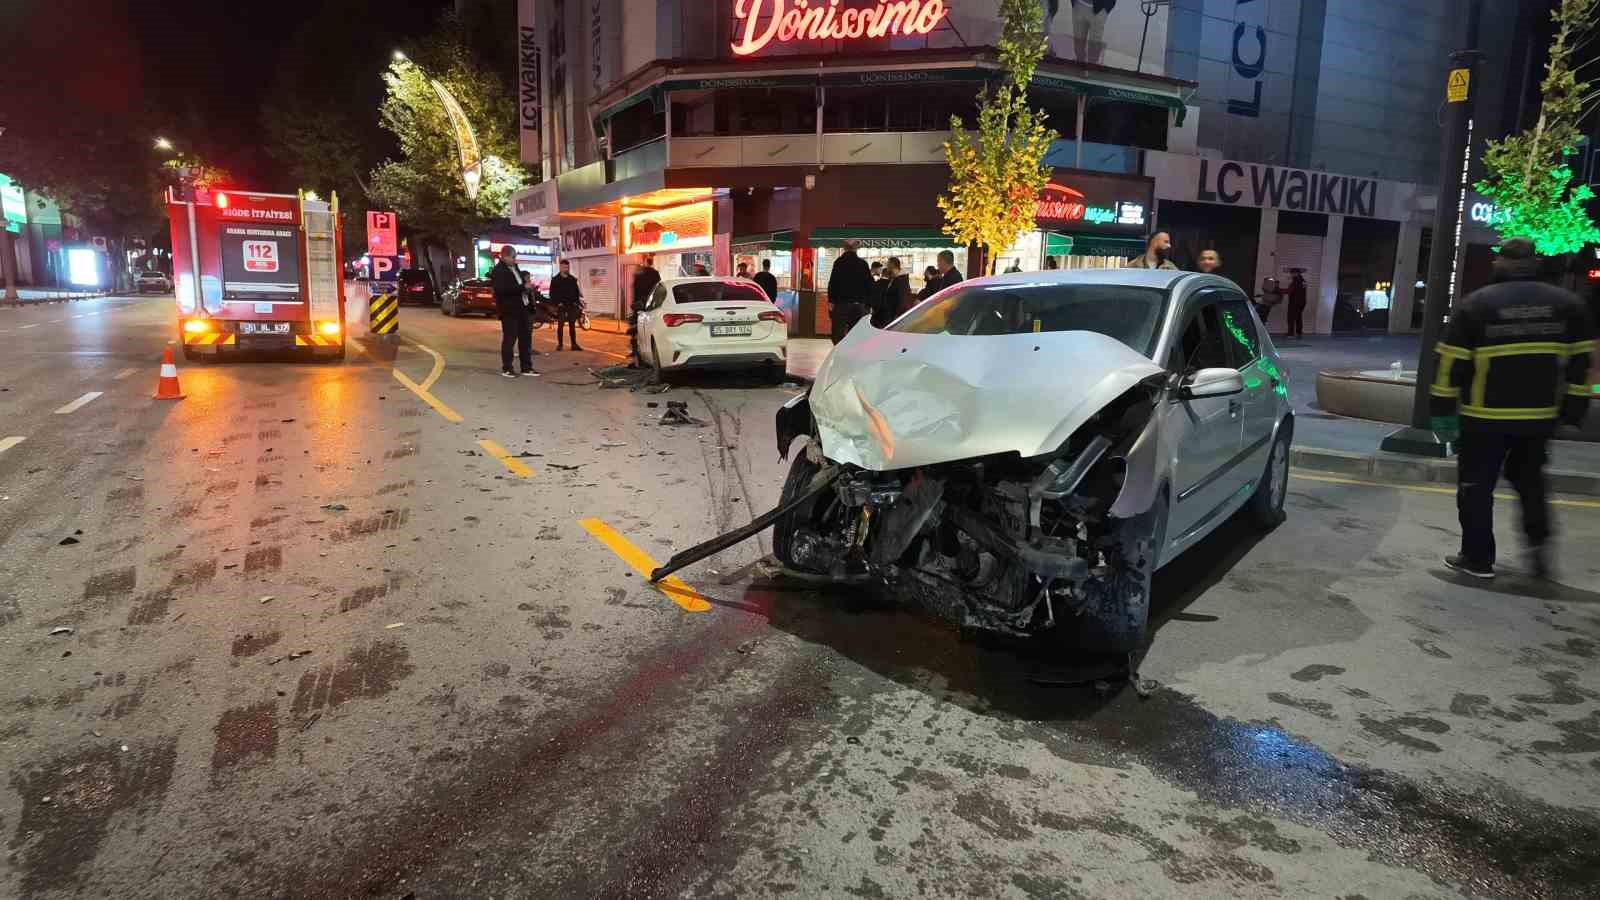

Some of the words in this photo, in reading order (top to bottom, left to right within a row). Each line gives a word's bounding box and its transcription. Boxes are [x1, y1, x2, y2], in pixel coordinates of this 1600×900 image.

[1198, 159, 1244, 203] LC
[375, 214, 388, 228] P
[248, 244, 272, 258] 112
[373, 257, 393, 279] P
